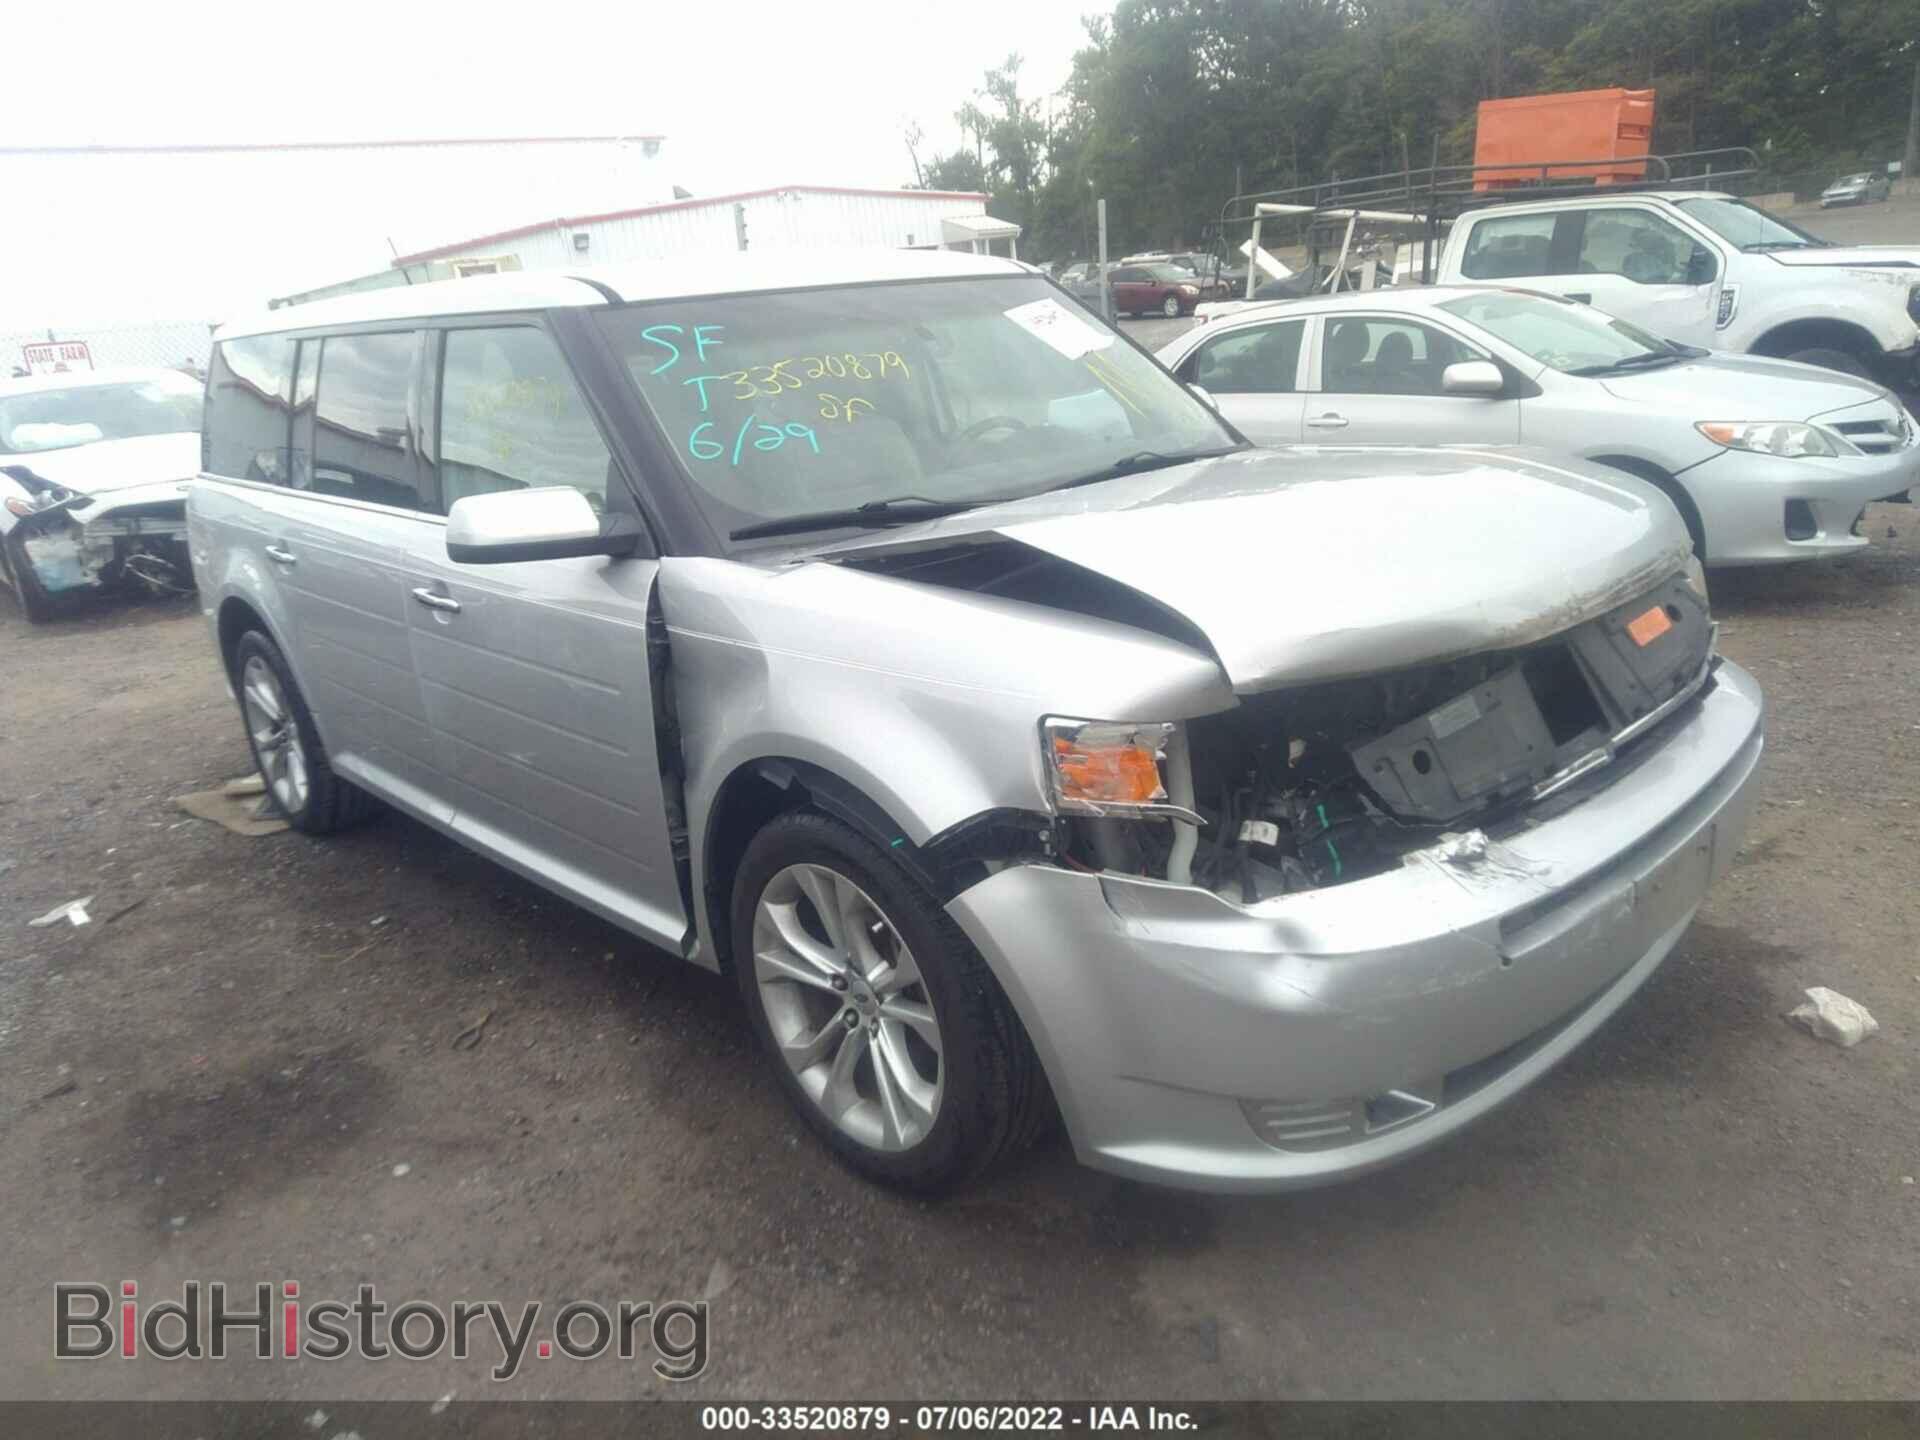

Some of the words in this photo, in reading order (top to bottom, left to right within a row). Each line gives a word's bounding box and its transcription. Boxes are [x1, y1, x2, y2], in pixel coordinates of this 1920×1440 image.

[28, 347, 55, 363] STATE
[719, 351, 911, 400] 33520879
[683, 375, 722, 412] T
[688, 414, 820, 465] 6/29
